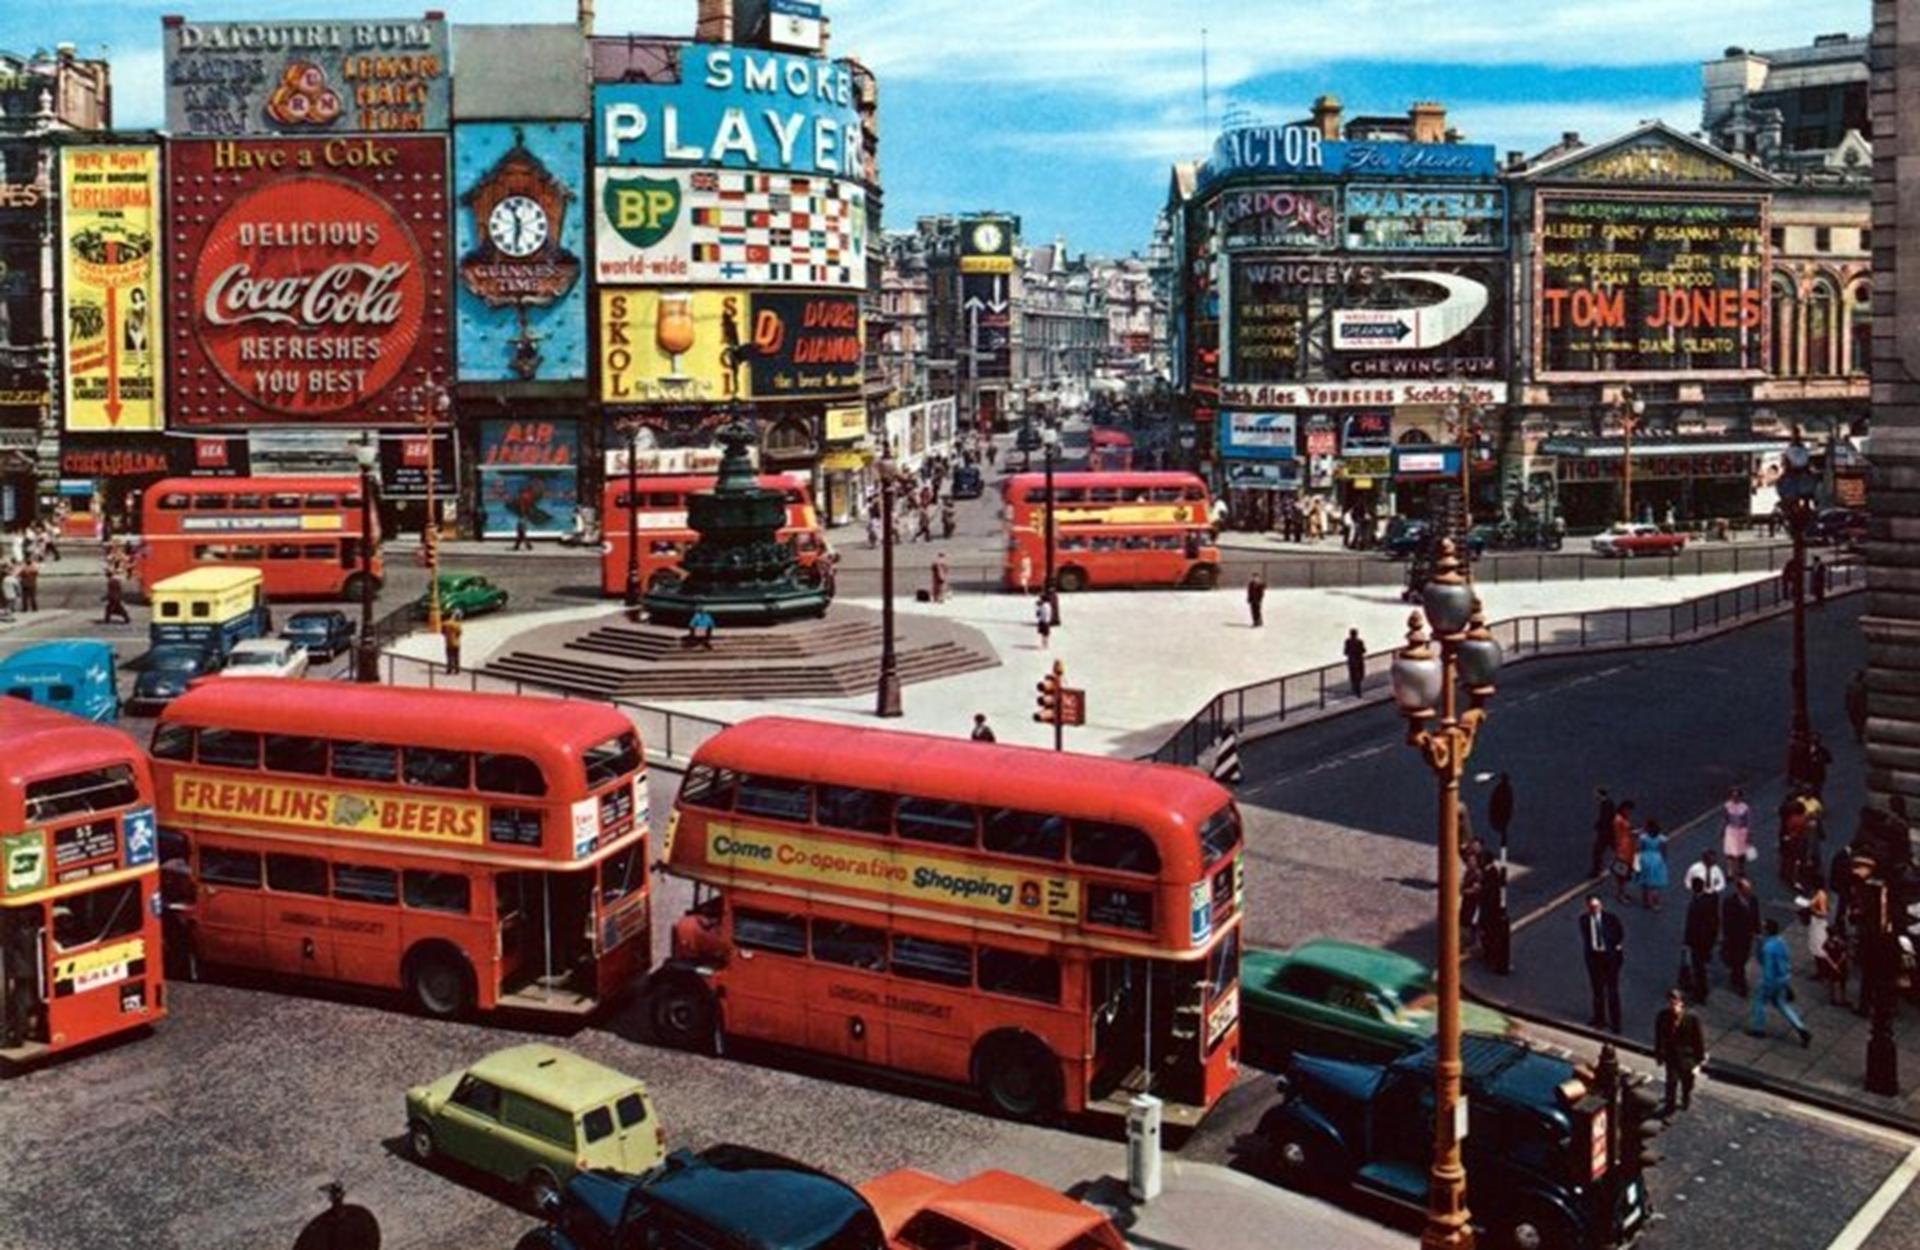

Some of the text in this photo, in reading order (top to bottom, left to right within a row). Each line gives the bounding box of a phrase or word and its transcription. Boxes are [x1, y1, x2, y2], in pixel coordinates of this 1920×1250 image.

[180, 25, 432, 50] DAIQUIRI RUM
[343, 56, 440, 79] LEMON
[706, 51, 851, 104] SMOKE
[214, 140, 399, 168] Have a Coke
[616, 190, 675, 229] BP
[1350, 192, 1498, 216] MARTELL
[240, 222, 381, 247] DELICIOUS
[1544, 224, 1594, 239] ALBERT
[1601, 225, 1646, 240] FINNEY
[1654, 226, 1720, 240] SUSANNAH
[600, 255, 688, 275] world-wide
[1544, 253, 1579, 267] HUGH
[1638, 272, 1714, 287] GREENWOOD
[204, 260, 411, 330] Coca-Cola
[1544, 288, 1760, 328] TOM JONES
[242, 336, 381, 360] REFRESHES
[608, 296, 631, 397] SKOL
[1639, 339, 1674, 352] DIANE
[1681, 340, 1734, 352] CILENTO
[1351, 361, 1444, 376] CHEWING
[256, 371, 365, 392] YOU BEST
[1256, 387, 1295, 403] Ales
[503, 423, 554, 442] AIR
[486, 445, 569, 465] INDIA
[179, 782, 329, 821] FREMLINS
[381, 802, 476, 837] BEERS
[713, 835, 772, 860] Come
[913, 867, 1014, 904] Shopping
